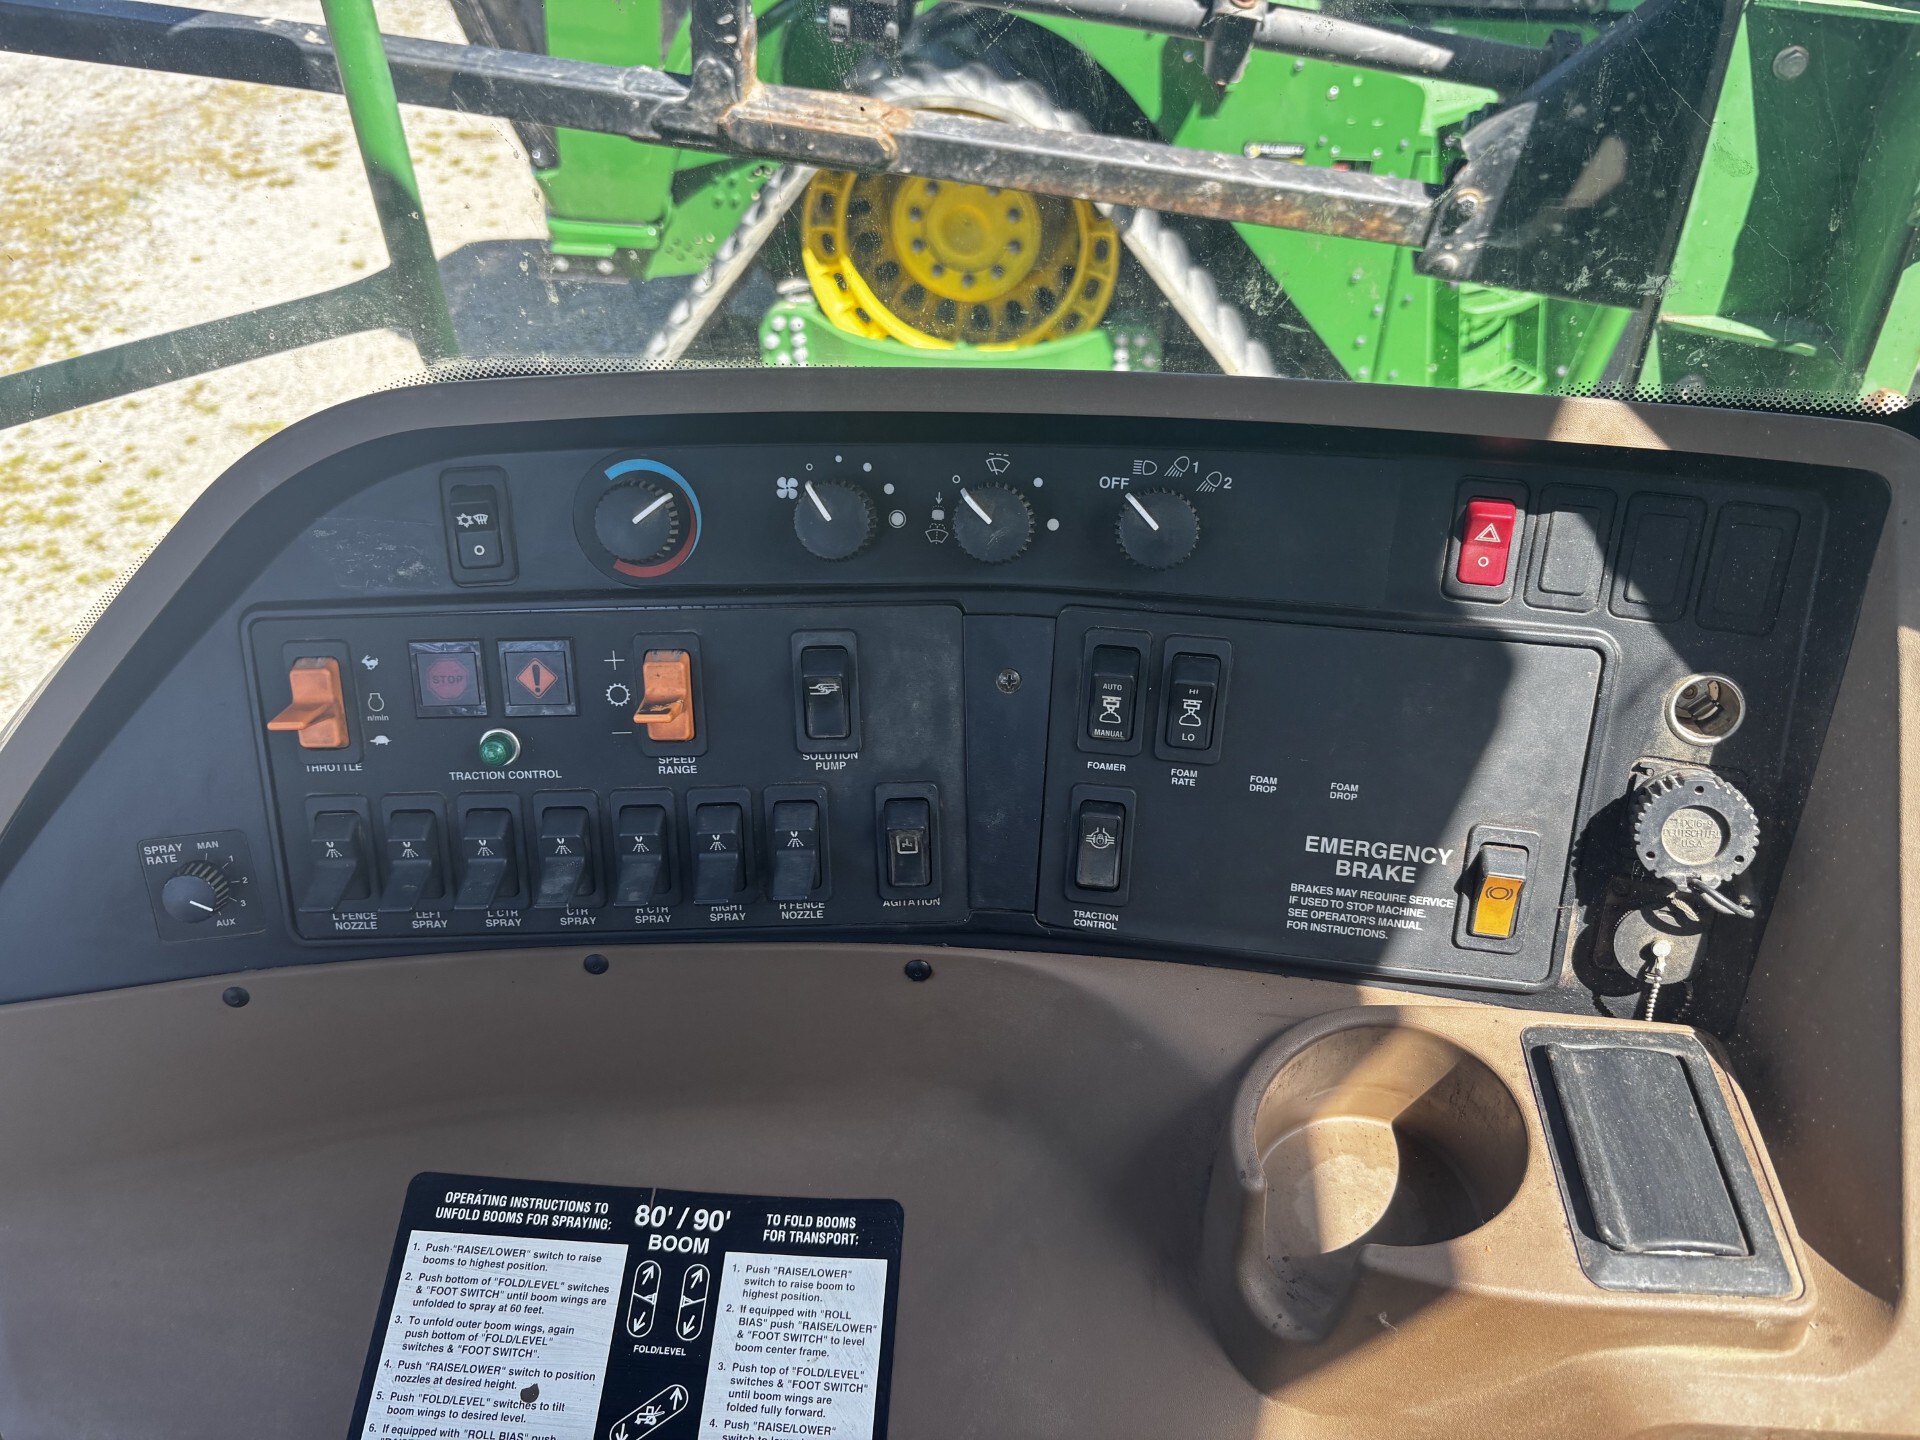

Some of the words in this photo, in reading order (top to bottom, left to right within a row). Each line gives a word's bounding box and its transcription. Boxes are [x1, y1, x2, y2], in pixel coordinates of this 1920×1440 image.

[1192, 461, 1199, 474] 1
[1099, 476, 1129, 489] OFF
[1223, 477, 1233, 489] 2
[432, 675, 463, 685] STOP
[1102, 683, 1123, 691] AUTO
[367, 714, 389, 722] n/min
[1094, 729, 1124, 738] MANUAL
[1181, 733, 1195, 742] LO
[658, 765, 698, 775] RANGE
[815, 762, 847, 771] PUMP
[1087, 761, 1126, 772] FOAMER
[448, 770, 505, 781] TRACTION
[508, 769, 562, 780] CONTROL
[1171, 768, 1198, 778] FOAM
[1171, 777, 1196, 787] RATE
[1249, 775, 1278, 786] FOAM
[1249, 783, 1277, 794] DROP
[1330, 782, 1359, 792] FOAM
[1329, 790, 1358, 801] DROP
[143, 843, 182, 855] SPRAY
[196, 841, 219, 850] MAN
[1305, 835, 1454, 866] EMERGENCY
[146, 854, 178, 865] RATE
[1335, 859, 1417, 884] BRAKE
[1290, 882, 1334, 896] BRAKES
[1335, 887, 1358, 898] MAY
[1359, 890, 1407, 904] REQUIRE
[1408, 895, 1457, 909] SERVICE
[882, 898, 941, 907] AGITATION
[1288, 895, 1299, 904] IF
[1300, 896, 1329, 908] USED
[1329, 899, 1344, 910] TO
[1346, 901, 1374, 912] STOP
[1376, 904, 1427, 919] MACHINE.
[634, 915, 672, 924] SPRAY
[709, 913, 746, 922] SPRAY
[781, 910, 824, 919] NOZZLE
[1073, 910, 1119, 922] TRACTION
[1287, 907, 1309, 919] SEE
[1310, 909, 1376, 926] OPERATOR'S
[1377, 917, 1423, 931] MANUAL
[216, 918, 236, 927] AUX
[335, 921, 378, 931] NOZZLE
[412, 920, 448, 929] SPRAY
[485, 918, 522, 928] SPRAY
[560, 917, 597, 926] SPRAY
[1073, 919, 1117, 931] CONTROL
[1286, 919, 1309, 931] FOR
[1310, 922, 1388, 940] INSTRUCTIONS.
[445, 1191, 508, 1207] OPERATING
[509, 1196, 592, 1213] INSTRUCTIONS
[594, 1202, 609, 1215] TO
[435, 1206, 481, 1221] UNFOLD
[482, 1209, 524, 1224] BOOMS
[525, 1212, 549, 1226] FOR
[551, 1214, 612, 1231] SPRAYING:
[634, 1204, 674, 1228] 80'
[676, 1206, 690, 1230] /
[693, 1208, 731, 1232] 90'
[766, 1213, 781, 1226] TO
[783, 1214, 813, 1228] FOLD
[816, 1215, 857, 1229] BOOMS
[648, 1233, 710, 1254] BOOM
[763, 1229, 786, 1242] FOR
[789, 1230, 859, 1246] TRANSPORT:
[413, 1242, 421, 1252] 1.
[425, 1242, 450, 1254] Push
[533, 1250, 564, 1261] switch
[566, 1252, 576, 1262] to
[578, 1253, 602, 1263] raise
[422, 1255, 455, 1266] booms
[457, 1257, 467, 1267] to
[468, 1258, 505, 1270] highest
[506, 1261, 548, 1272] position.
[733, 1263, 740, 1273] 1.
[745, 1264, 770, 1275] Push
[404, 1271, 413, 1281] 2.
[418, 1272, 443, 1283] Push
[444, 1274, 479, 1285] bottom
[481, 1276, 492, 1286] of
[567, 1282, 610, 1294] switches
[744, 1277, 775, 1287] switch
[778, 1279, 788, 1288] to
[790, 1279, 814, 1290] raise
[816, 1280, 843, 1291] boom
[846, 1283, 856, 1292] to
[415, 1285, 423, 1294] &
[506, 1291, 529, 1301] until
[530, 1292, 558, 1303] boom
[560, 1294, 589, 1307] wings
[591, 1297, 607, 1306] are
[742, 1288, 779, 1301] highest
[780, 1292, 823, 1302] position.
[412, 1298, 455, 1309] unfolded
[457, 1300, 467, 1310] to
[468, 1302, 497, 1314] spray
[497, 1303, 508, 1312] at
[509, 1303, 522, 1313] 60
[523, 1304, 544, 1315] feet.
[394, 1314, 403, 1324] 3.
[409, 1315, 421, 1325] To
[422, 1317, 455, 1327] unfold
[455, 1319, 482, 1329] outer
[484, 1320, 513, 1331] boom
[514, 1322, 545, 1335] wings,
[547, 1325, 575, 1336] again
[401, 1341, 444, 1353] switches
[446, 1344, 454, 1354] &
[633, 1344, 687, 1356] FOLD/LEVEL
[394, 1374, 431, 1384] nozzles
[433, 1376, 443, 1385] at
[445, 1376, 483, 1388] desired
[483, 1378, 517, 1391] height.
[386, 1404, 415, 1416] boom
[417, 1407, 446, 1420] wings
[448, 1409, 459, 1419] to
[461, 1409, 499, 1421] desired
[500, 1412, 526, 1423] level.
[726, 1401, 758, 1414] folded
[760, 1403, 783, 1417] fully
[785, 1405, 826, 1418] forward.
